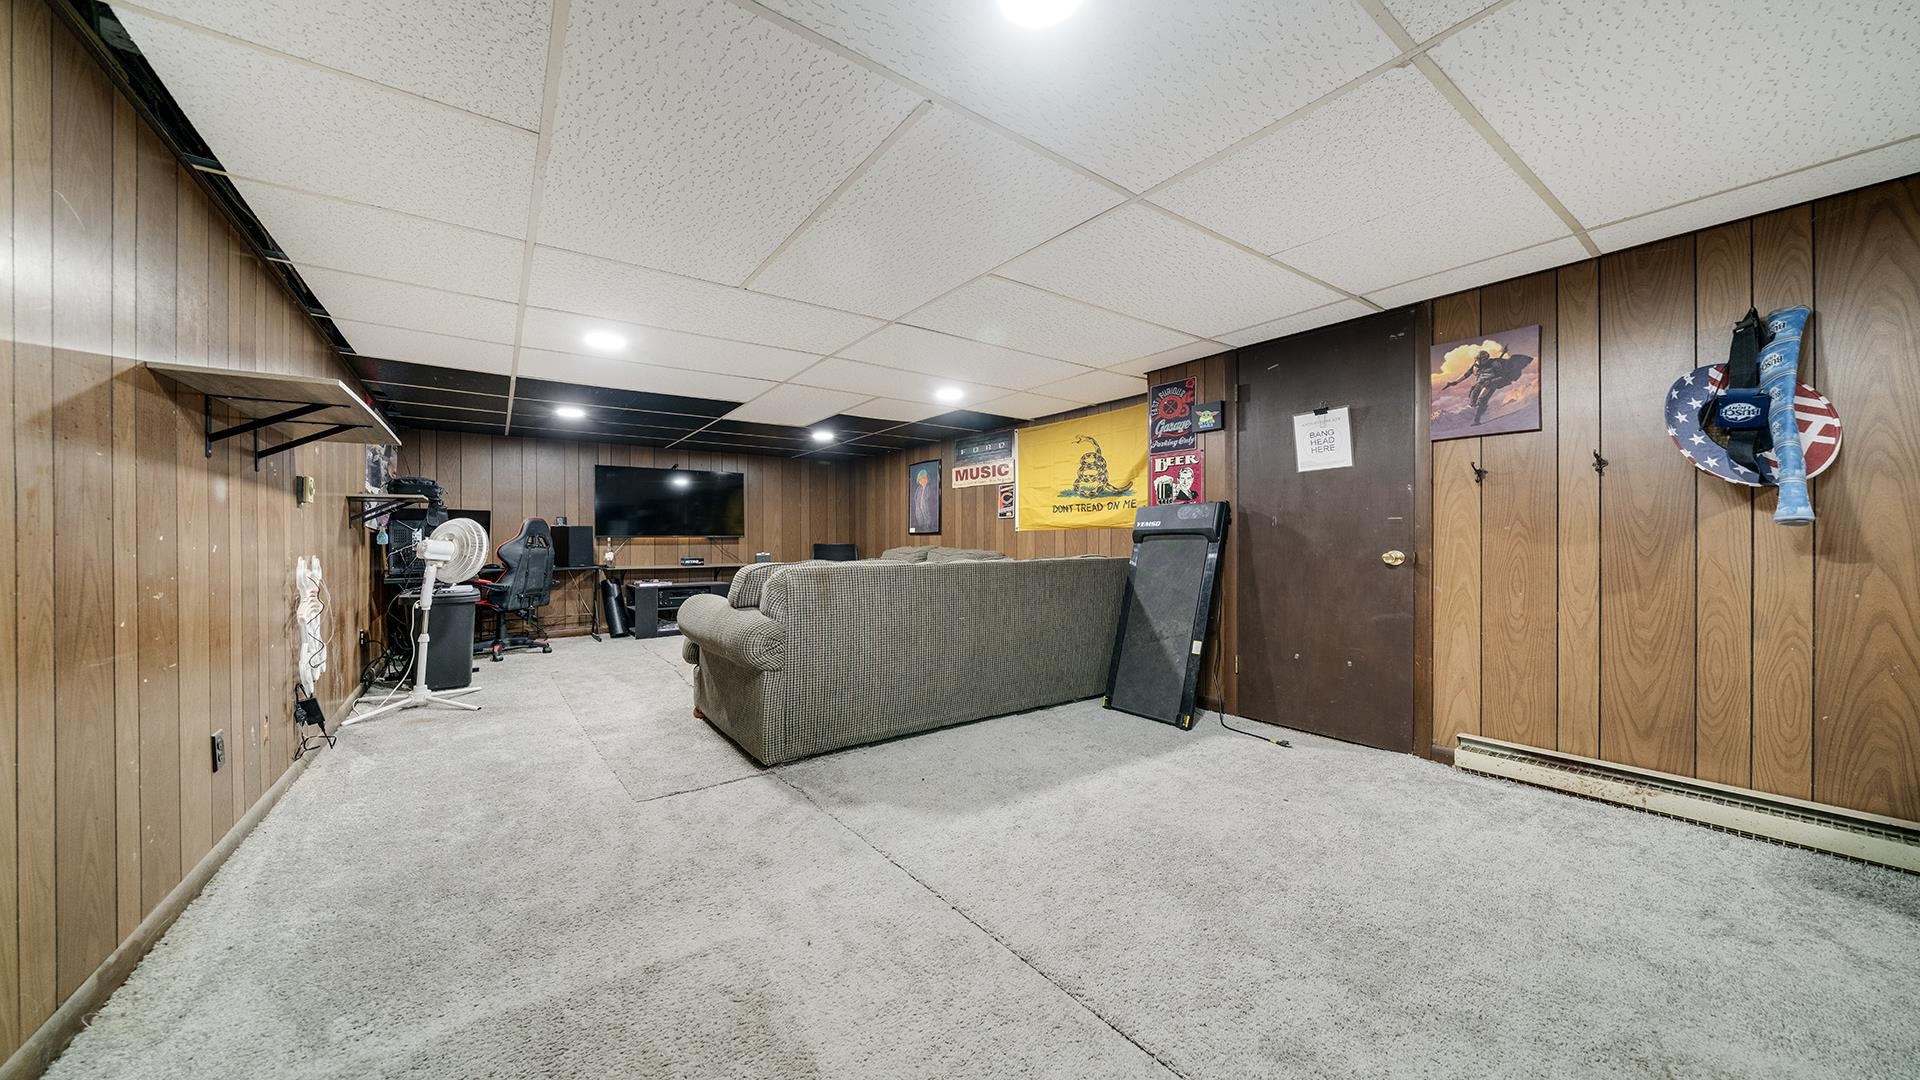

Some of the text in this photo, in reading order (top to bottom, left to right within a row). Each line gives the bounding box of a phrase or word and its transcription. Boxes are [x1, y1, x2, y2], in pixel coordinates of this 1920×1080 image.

[1720, 407, 1760, 417] BUSCH
[1155, 419, 1192, 438] Garage
[1309, 429, 1335, 439] BANG
[1150, 436, 1195, 449] Parking Only
[1310, 436, 1335, 446] HEAD
[960, 442, 1006, 455] FORD
[1311, 444, 1335, 454] HERE
[1154, 454, 1200, 473] BEER
[955, 463, 1010, 482] MUSIC
[1052, 499, 1137, 514] DONT TREAD ON ME
